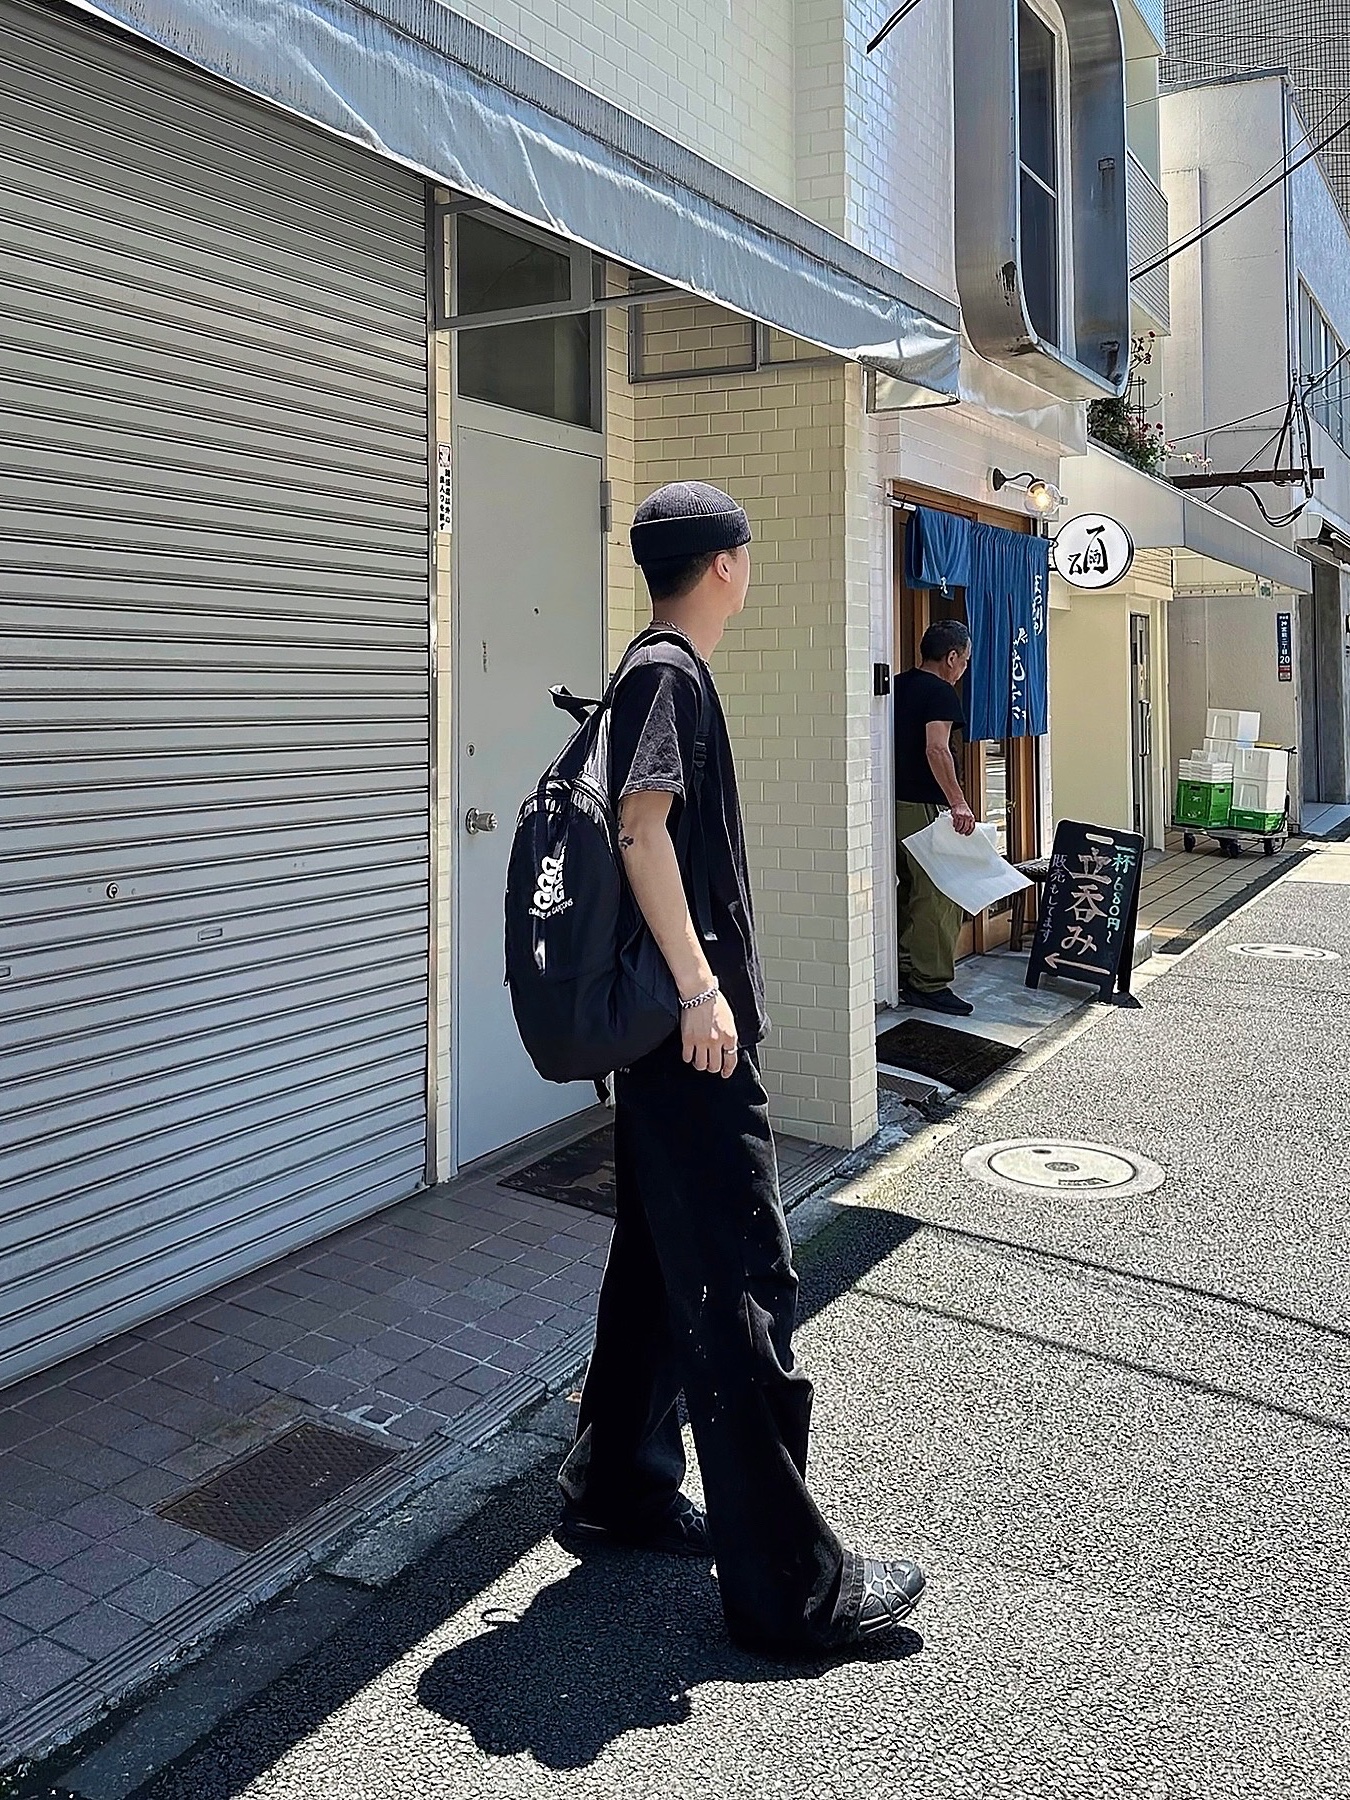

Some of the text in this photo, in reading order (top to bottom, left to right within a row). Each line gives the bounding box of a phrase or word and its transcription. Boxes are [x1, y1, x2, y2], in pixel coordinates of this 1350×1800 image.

[1280, 656, 1290, 664] 20
[1042, 854, 1069, 943] 販売もしてます
[1061, 847, 1113, 955] 立呑み
